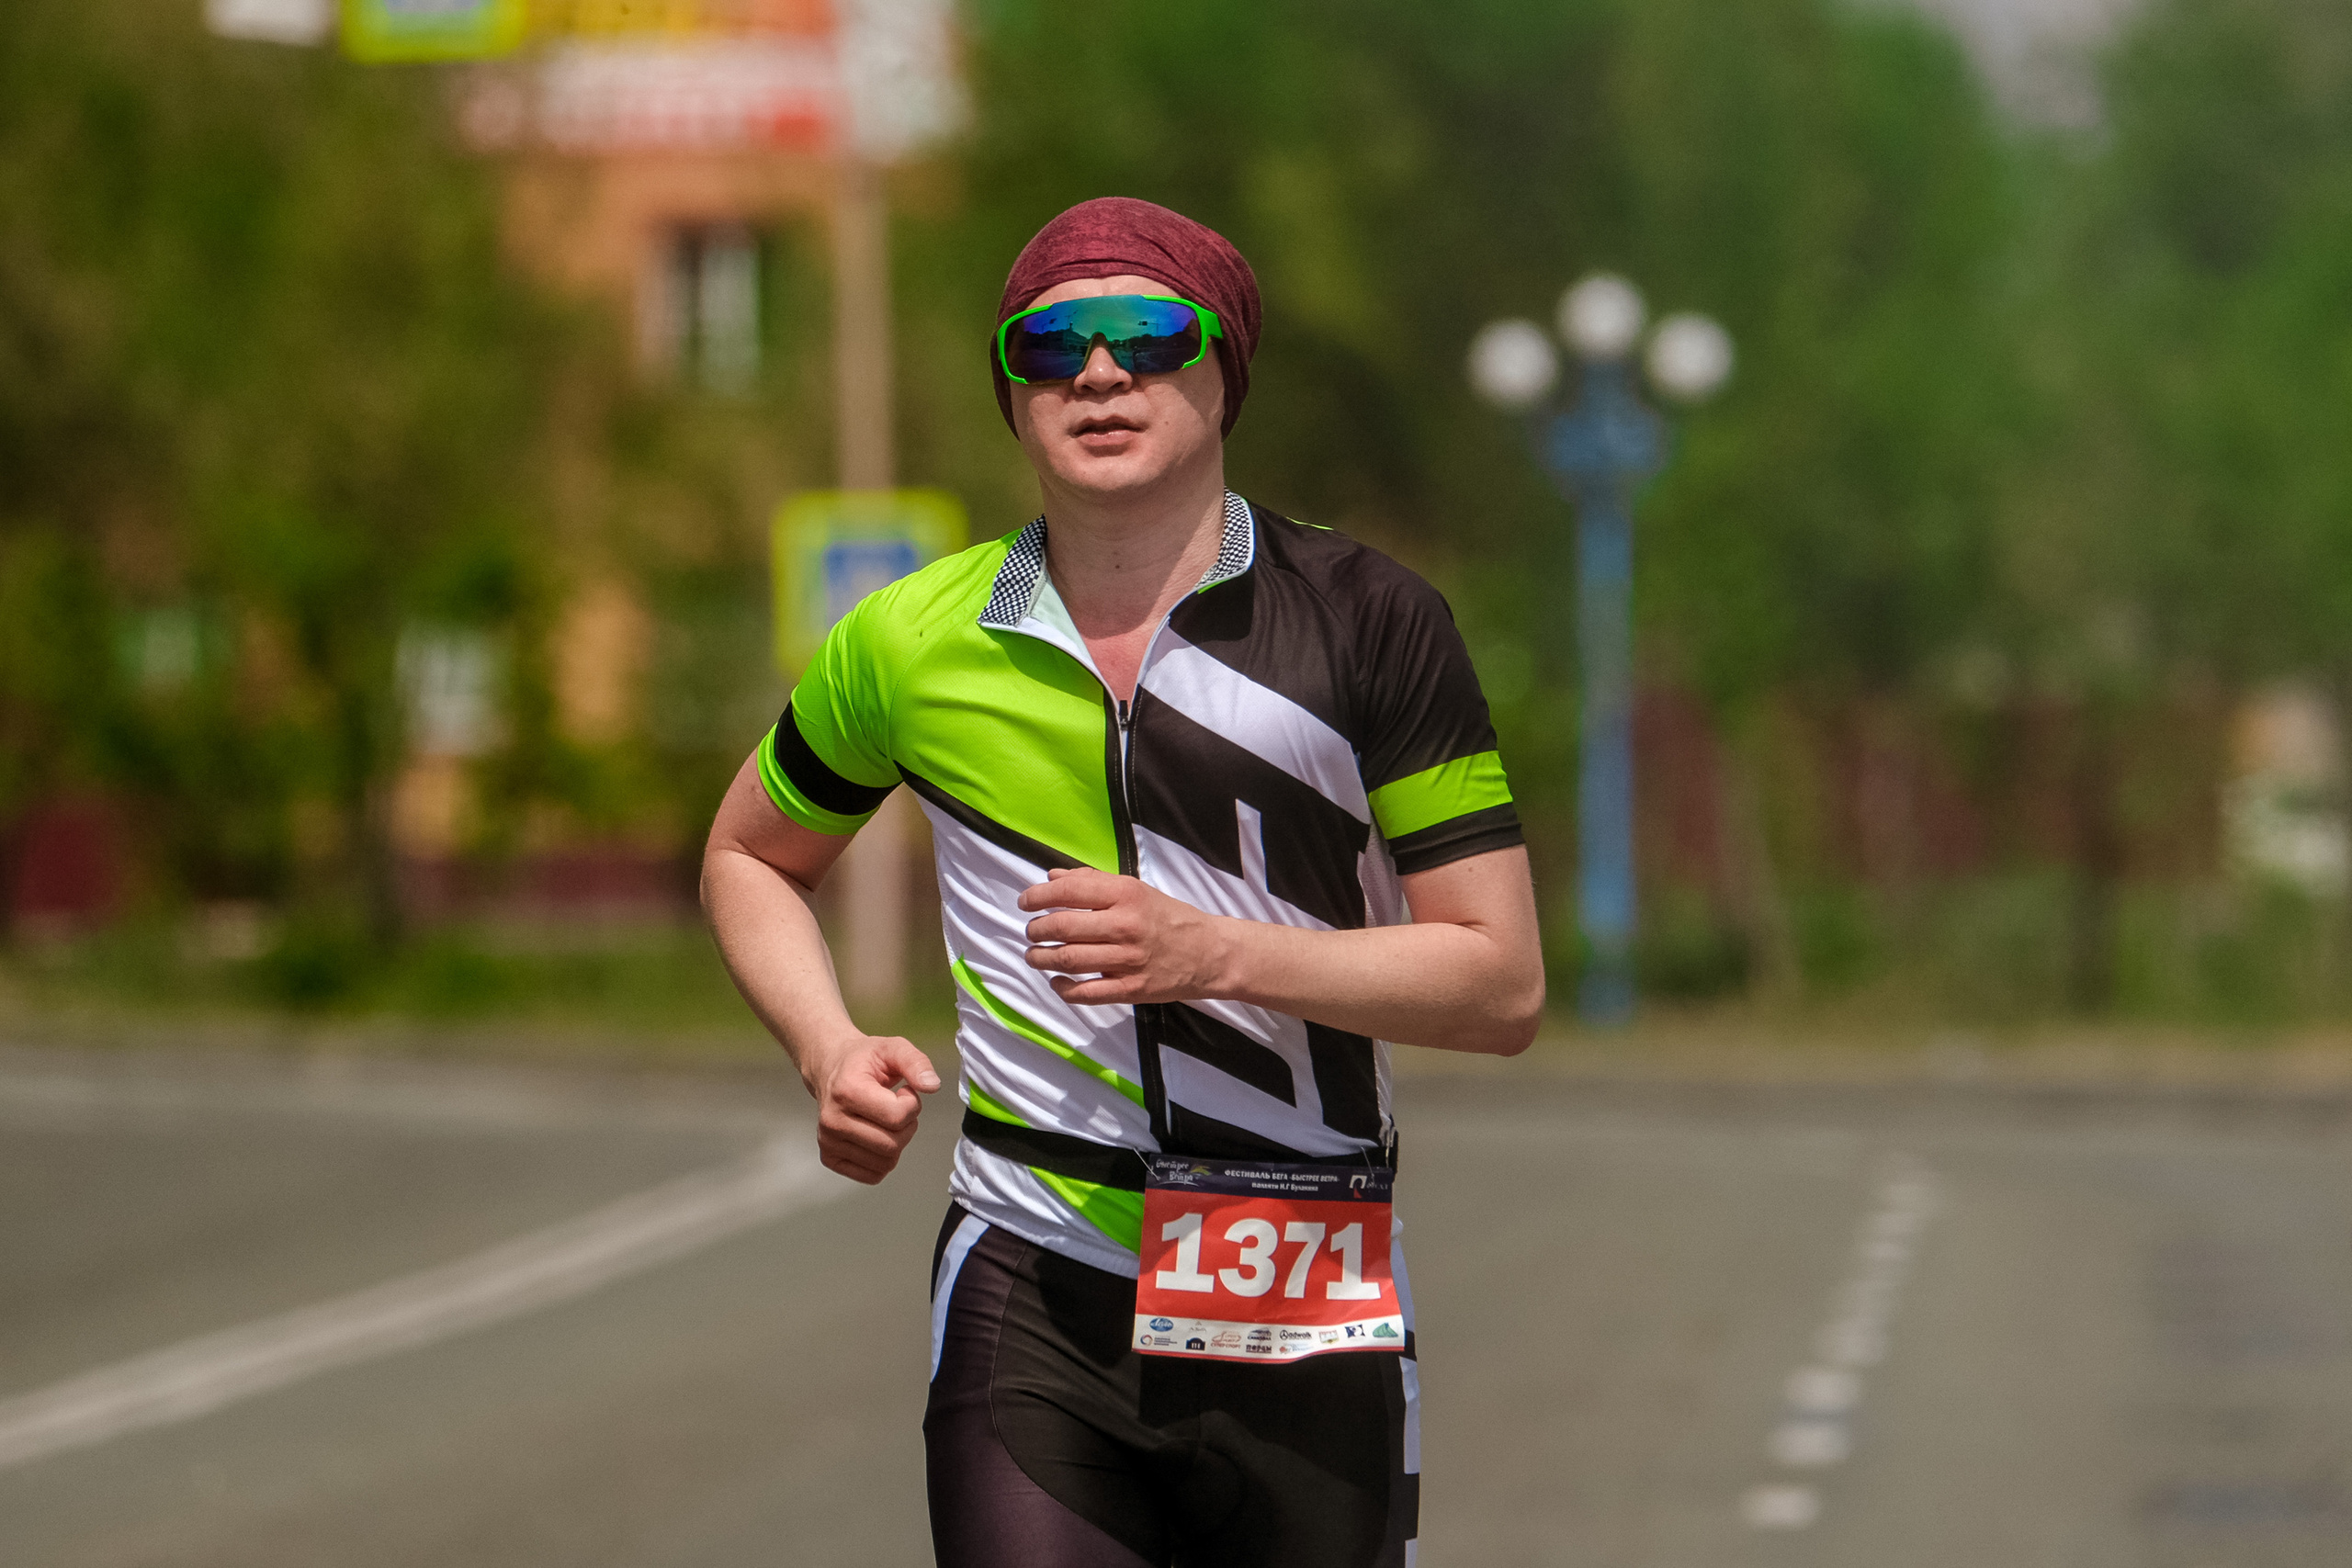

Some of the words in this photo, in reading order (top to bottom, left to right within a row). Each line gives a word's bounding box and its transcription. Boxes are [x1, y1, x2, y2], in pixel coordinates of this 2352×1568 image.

[1224, 1169, 1271, 1179] ФЕСТИВАЛЬ
[1272, 1172, 1288, 1180] БЕГА
[1155, 1213, 1382, 1301] 1371
